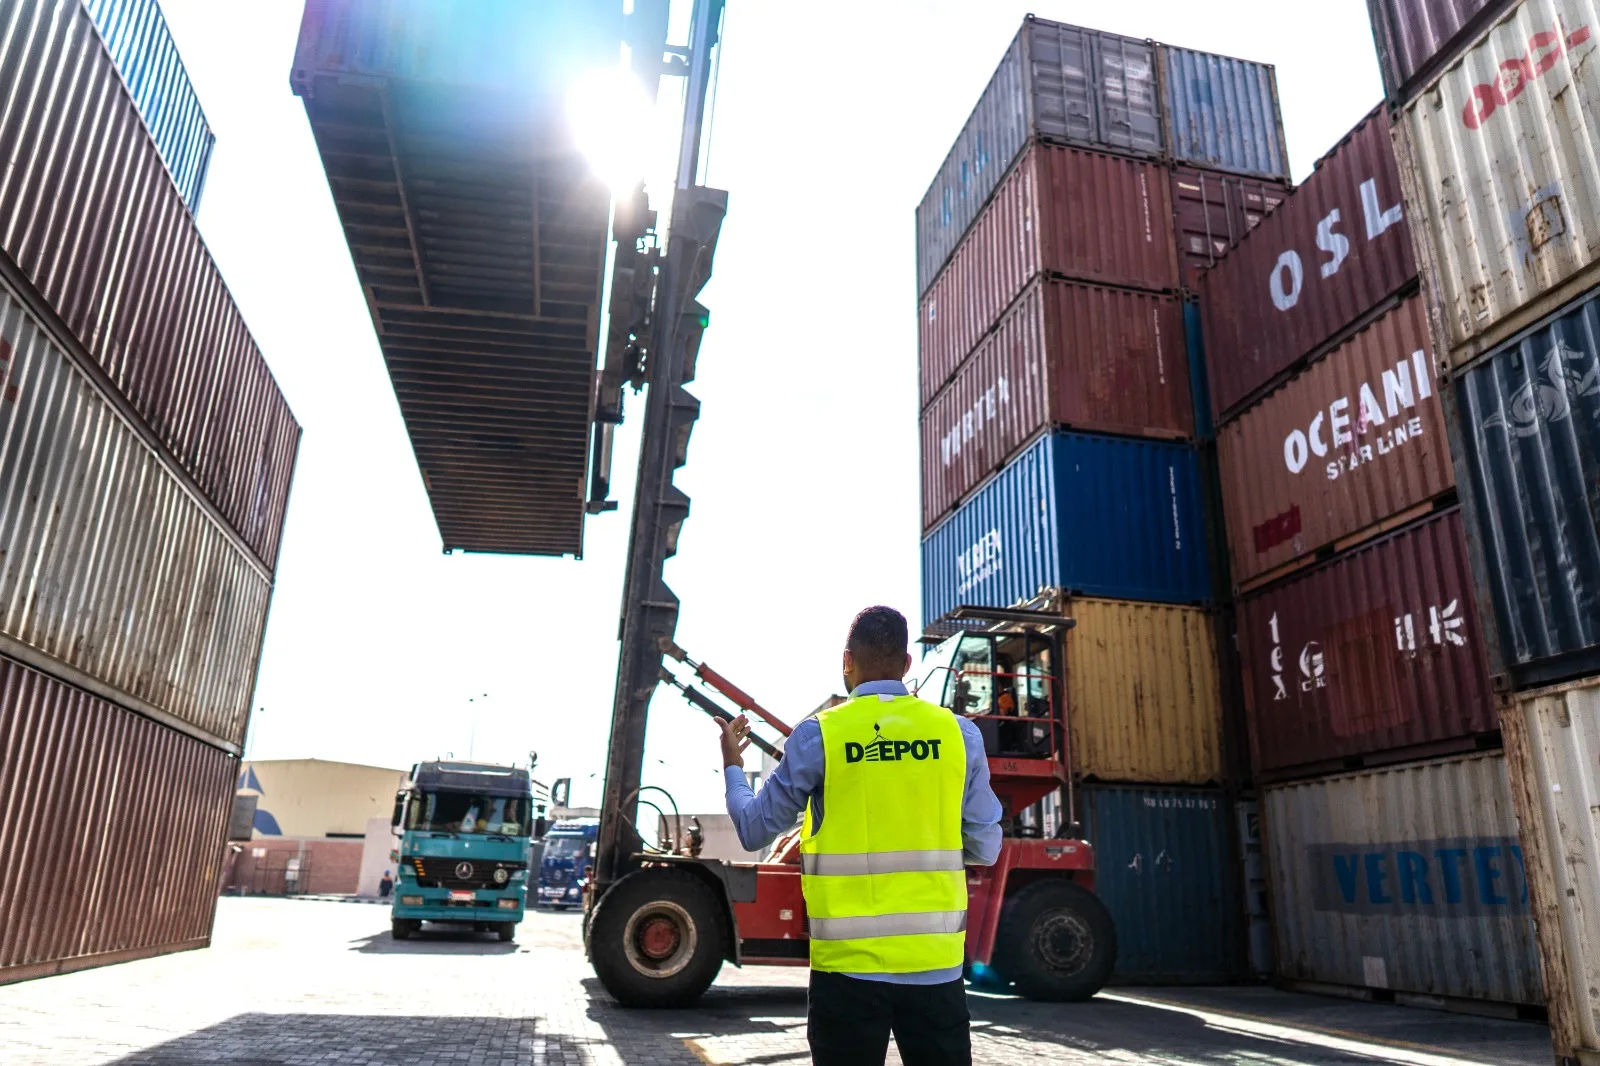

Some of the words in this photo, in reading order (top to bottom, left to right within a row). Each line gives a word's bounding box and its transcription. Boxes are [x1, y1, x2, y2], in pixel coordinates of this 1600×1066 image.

[1463, 21, 1591, 131] OOCL
[1284, 349, 1437, 474] OCEANI
[1326, 444, 1373, 480] STAR
[1377, 416, 1424, 456] LINE
